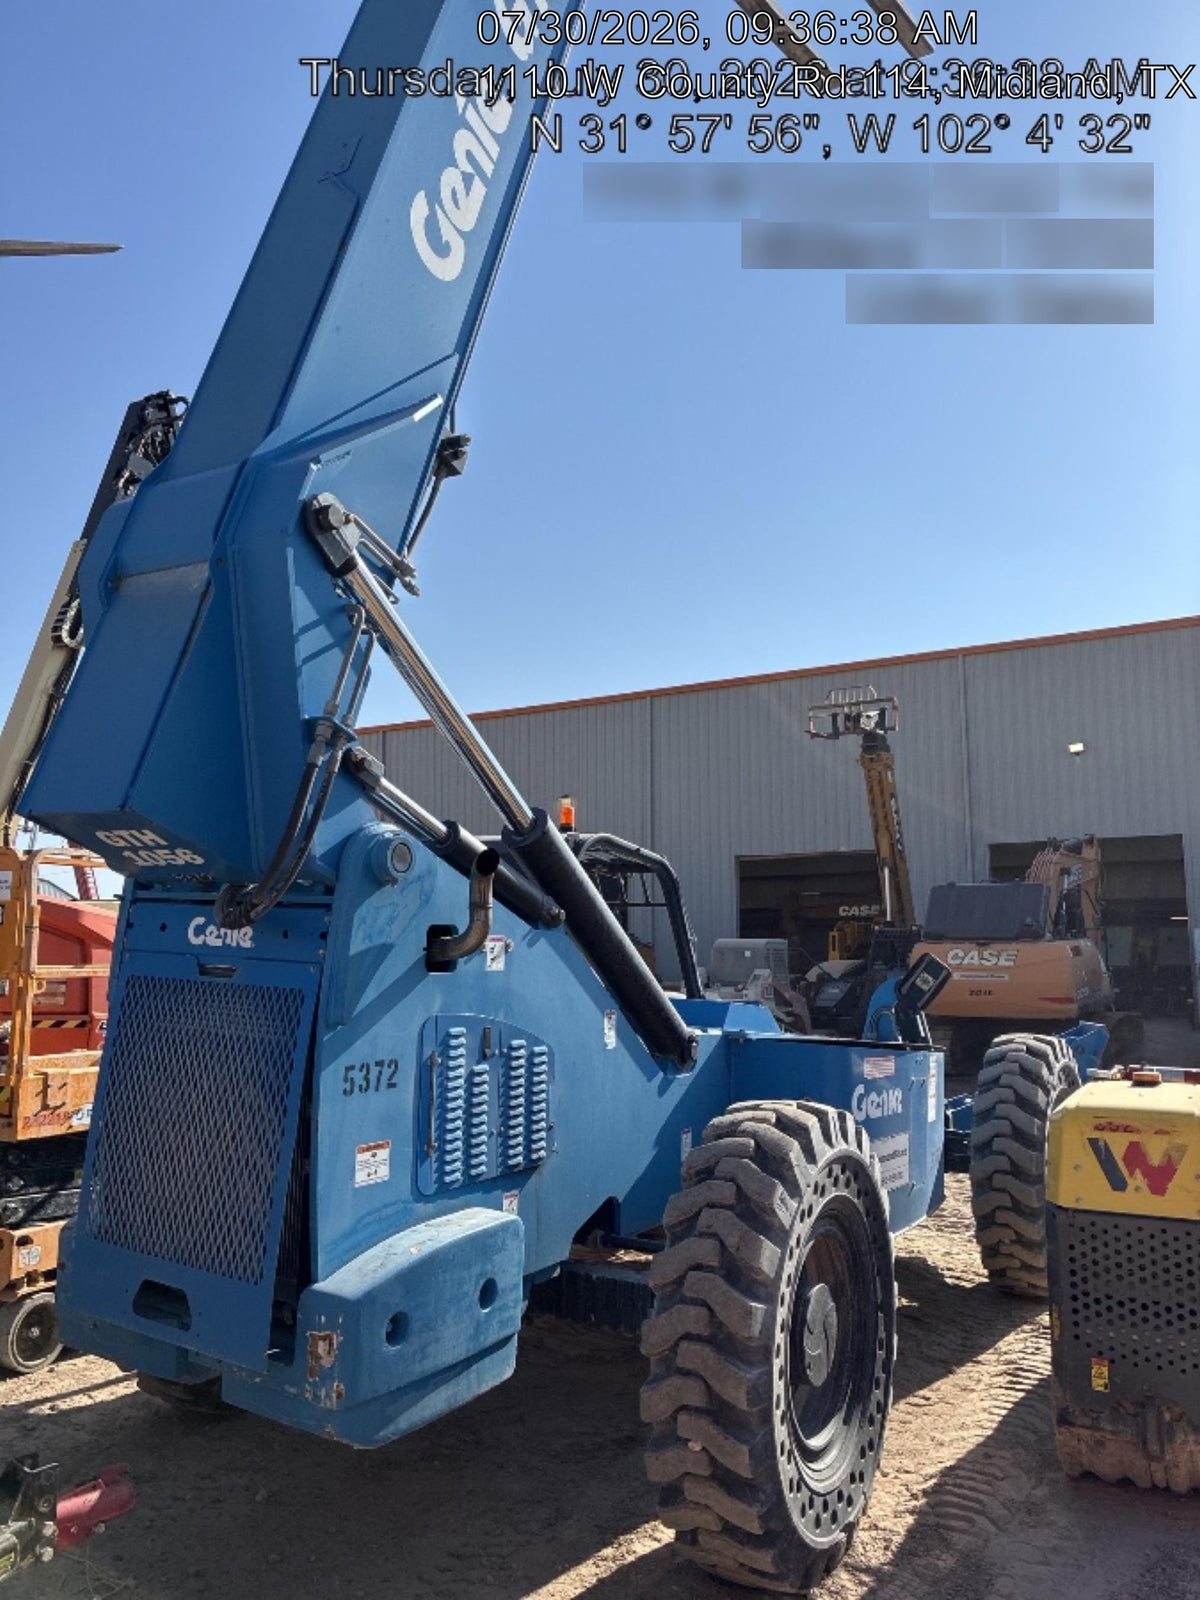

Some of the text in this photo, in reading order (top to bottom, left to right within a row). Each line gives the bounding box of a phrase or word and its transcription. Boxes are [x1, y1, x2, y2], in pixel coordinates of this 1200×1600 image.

[410, 74, 514, 281] Genie
[95, 829, 169, 848] GTH
[122, 847, 205, 867] 1056
[838, 904, 881, 917] CASE
[946, 948, 1019, 967] CASE
[342, 1058, 399, 1097] 5372
[851, 1083, 903, 1122] Genie
